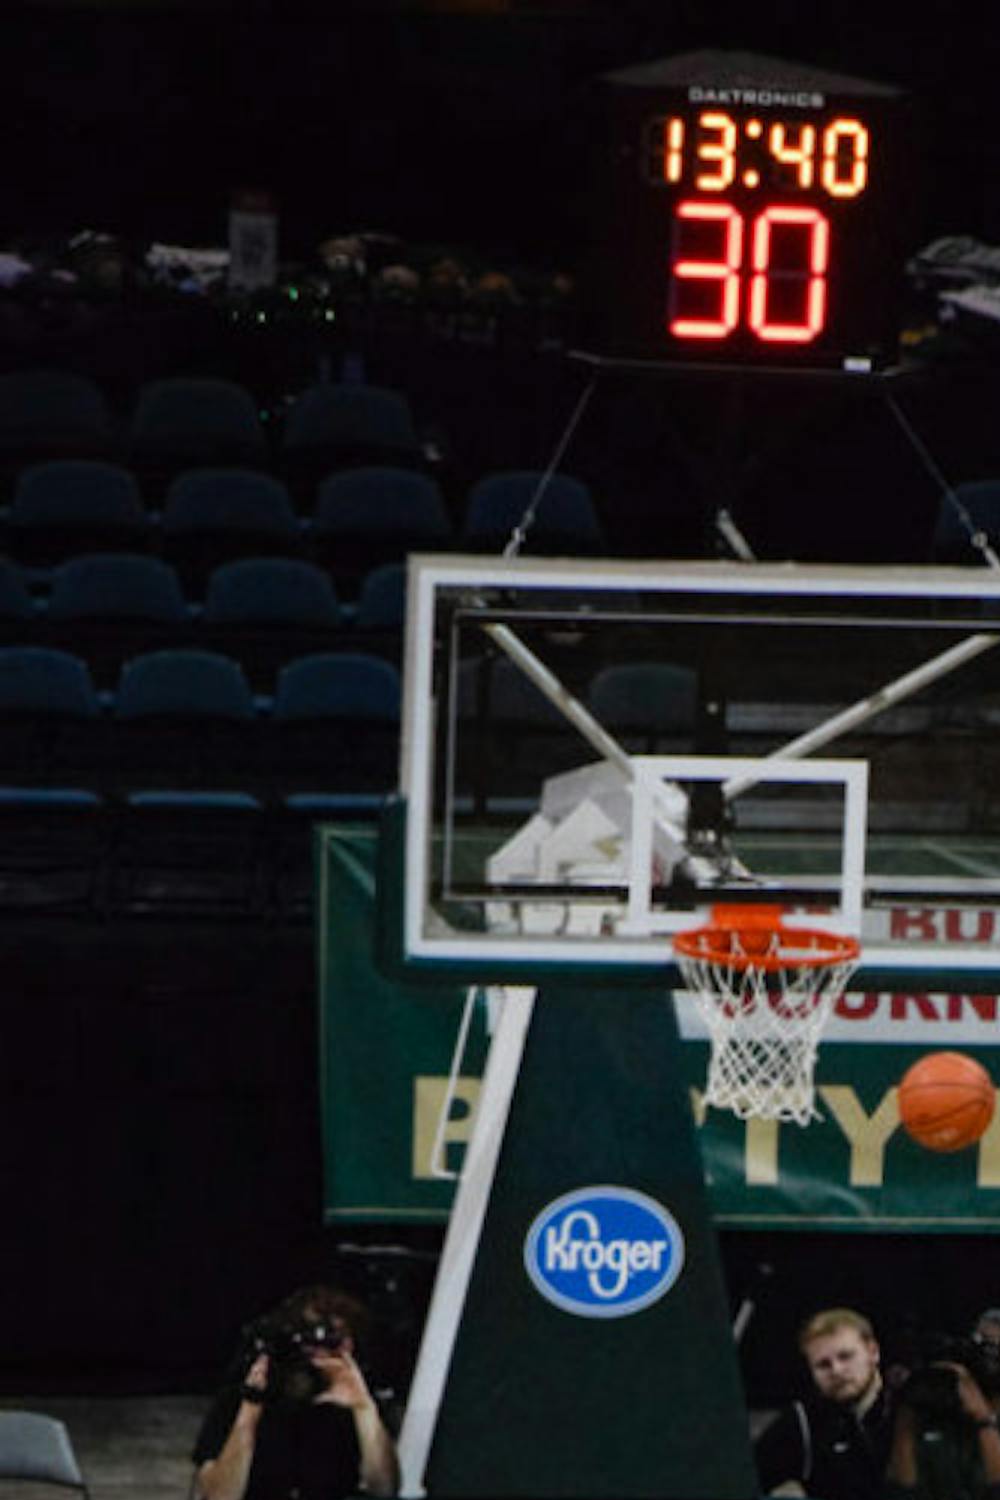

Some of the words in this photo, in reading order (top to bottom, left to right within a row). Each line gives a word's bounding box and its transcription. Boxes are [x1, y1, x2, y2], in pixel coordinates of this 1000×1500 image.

[687, 85, 825, 107] DAKTRONICS
[665, 113, 869, 197] 13:40
[670, 202, 829, 343] 30
[412, 1075, 905, 1188] PTY
[545, 1208, 668, 1299] Kroger
